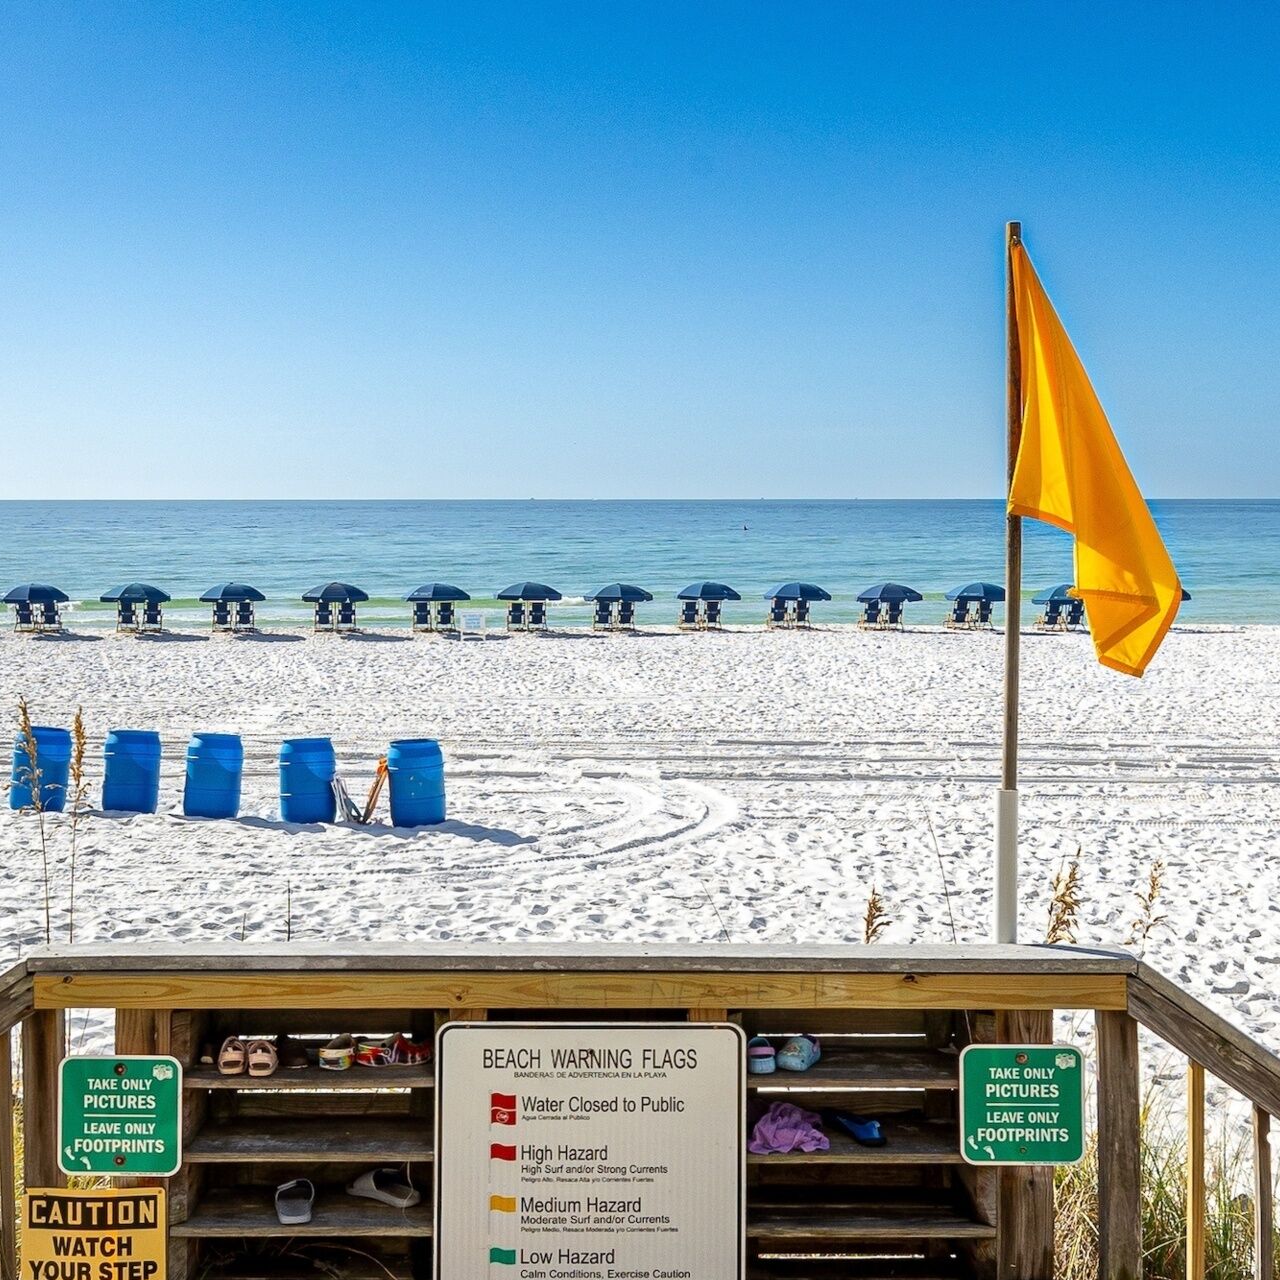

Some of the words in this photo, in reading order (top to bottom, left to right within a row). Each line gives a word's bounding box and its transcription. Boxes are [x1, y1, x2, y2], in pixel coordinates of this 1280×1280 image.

[483, 1049, 540, 1069] BEACH
[551, 1049, 632, 1069] WARNING
[643, 1049, 697, 1069] FLAGS
[989, 1068, 1020, 1079] TAKE
[1024, 1068, 1055, 1079] ONLY
[87, 1079, 118, 1090] TAKE
[122, 1079, 152, 1090] ONLY
[986, 1084, 1059, 1097] PICTURES
[84, 1095, 156, 1109] PICTURES
[522, 1096, 564, 1112] Water
[569, 1096, 618, 1112] Closed
[623, 1097, 636, 1112] to
[641, 1097, 684, 1112] Public
[987, 1112, 1024, 1123] LEAVE
[1028, 1112, 1059, 1123] ONLY
[84, 1123, 121, 1134] LEAVE
[125, 1123, 155, 1134] ONLY
[978, 1128, 1069, 1142] FOOTPRINTS
[75, 1139, 164, 1153] FOOTPRINTS
[521, 1145, 552, 1164] High
[558, 1145, 607, 1161] Hazard
[521, 1165, 542, 1175] High
[545, 1165, 564, 1173] Surf
[566, 1165, 594, 1173] and/or
[597, 1165, 627, 1175] Strong
[629, 1165, 668, 1173] Currents
[521, 1197, 581, 1213] Medium
[587, 1197, 641, 1213] Hazard
[32, 1200, 154, 1225] CAUTION
[521, 1216, 567, 1224] Moderate
[570, 1215, 591, 1224] Surf
[594, 1215, 625, 1224] and/or
[628, 1215, 670, 1223] Currents
[52, 1236, 132, 1257] WATCH
[521, 1249, 553, 1264] Low
[559, 1249, 614, 1264] Hazard
[521, 1270, 546, 1278] Calm
[549, 1270, 604, 1279] Conditions,
[608, 1270, 650, 1278] Exercise
[653, 1270, 690, 1278] Caution
